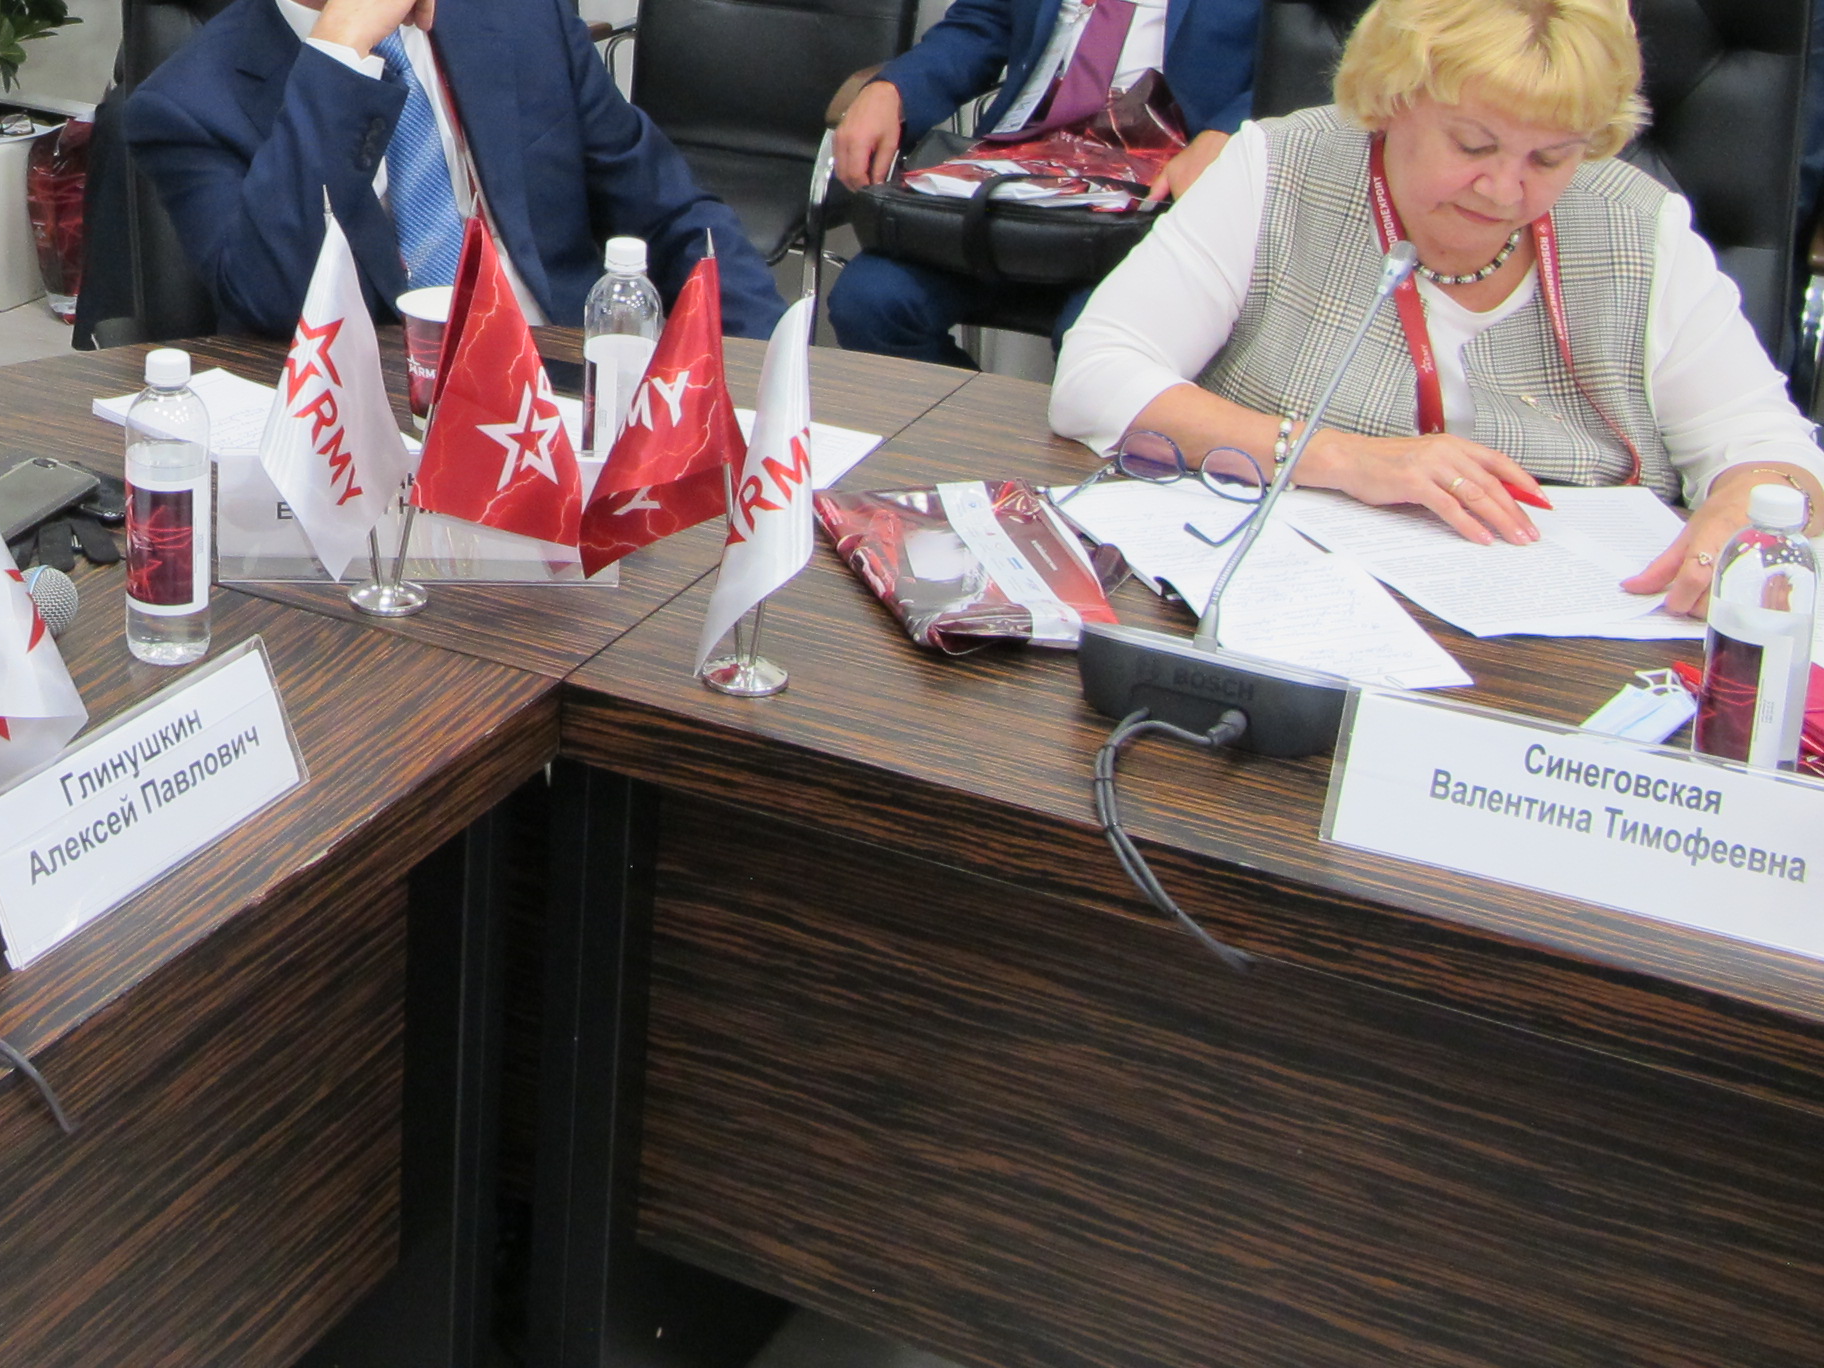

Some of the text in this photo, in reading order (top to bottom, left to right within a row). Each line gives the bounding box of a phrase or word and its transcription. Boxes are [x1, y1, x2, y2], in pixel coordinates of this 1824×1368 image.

[1373, 176, 1399, 251] ORONEXPORT
[406, 353, 437, 380] ARM
[59, 709, 203, 807] Глинушкин
[1523, 743, 1724, 815] Синеговская
[29, 725, 261, 886] Алексей Павлович
[1429, 768, 1808, 883] Валентина Тимофеевна
